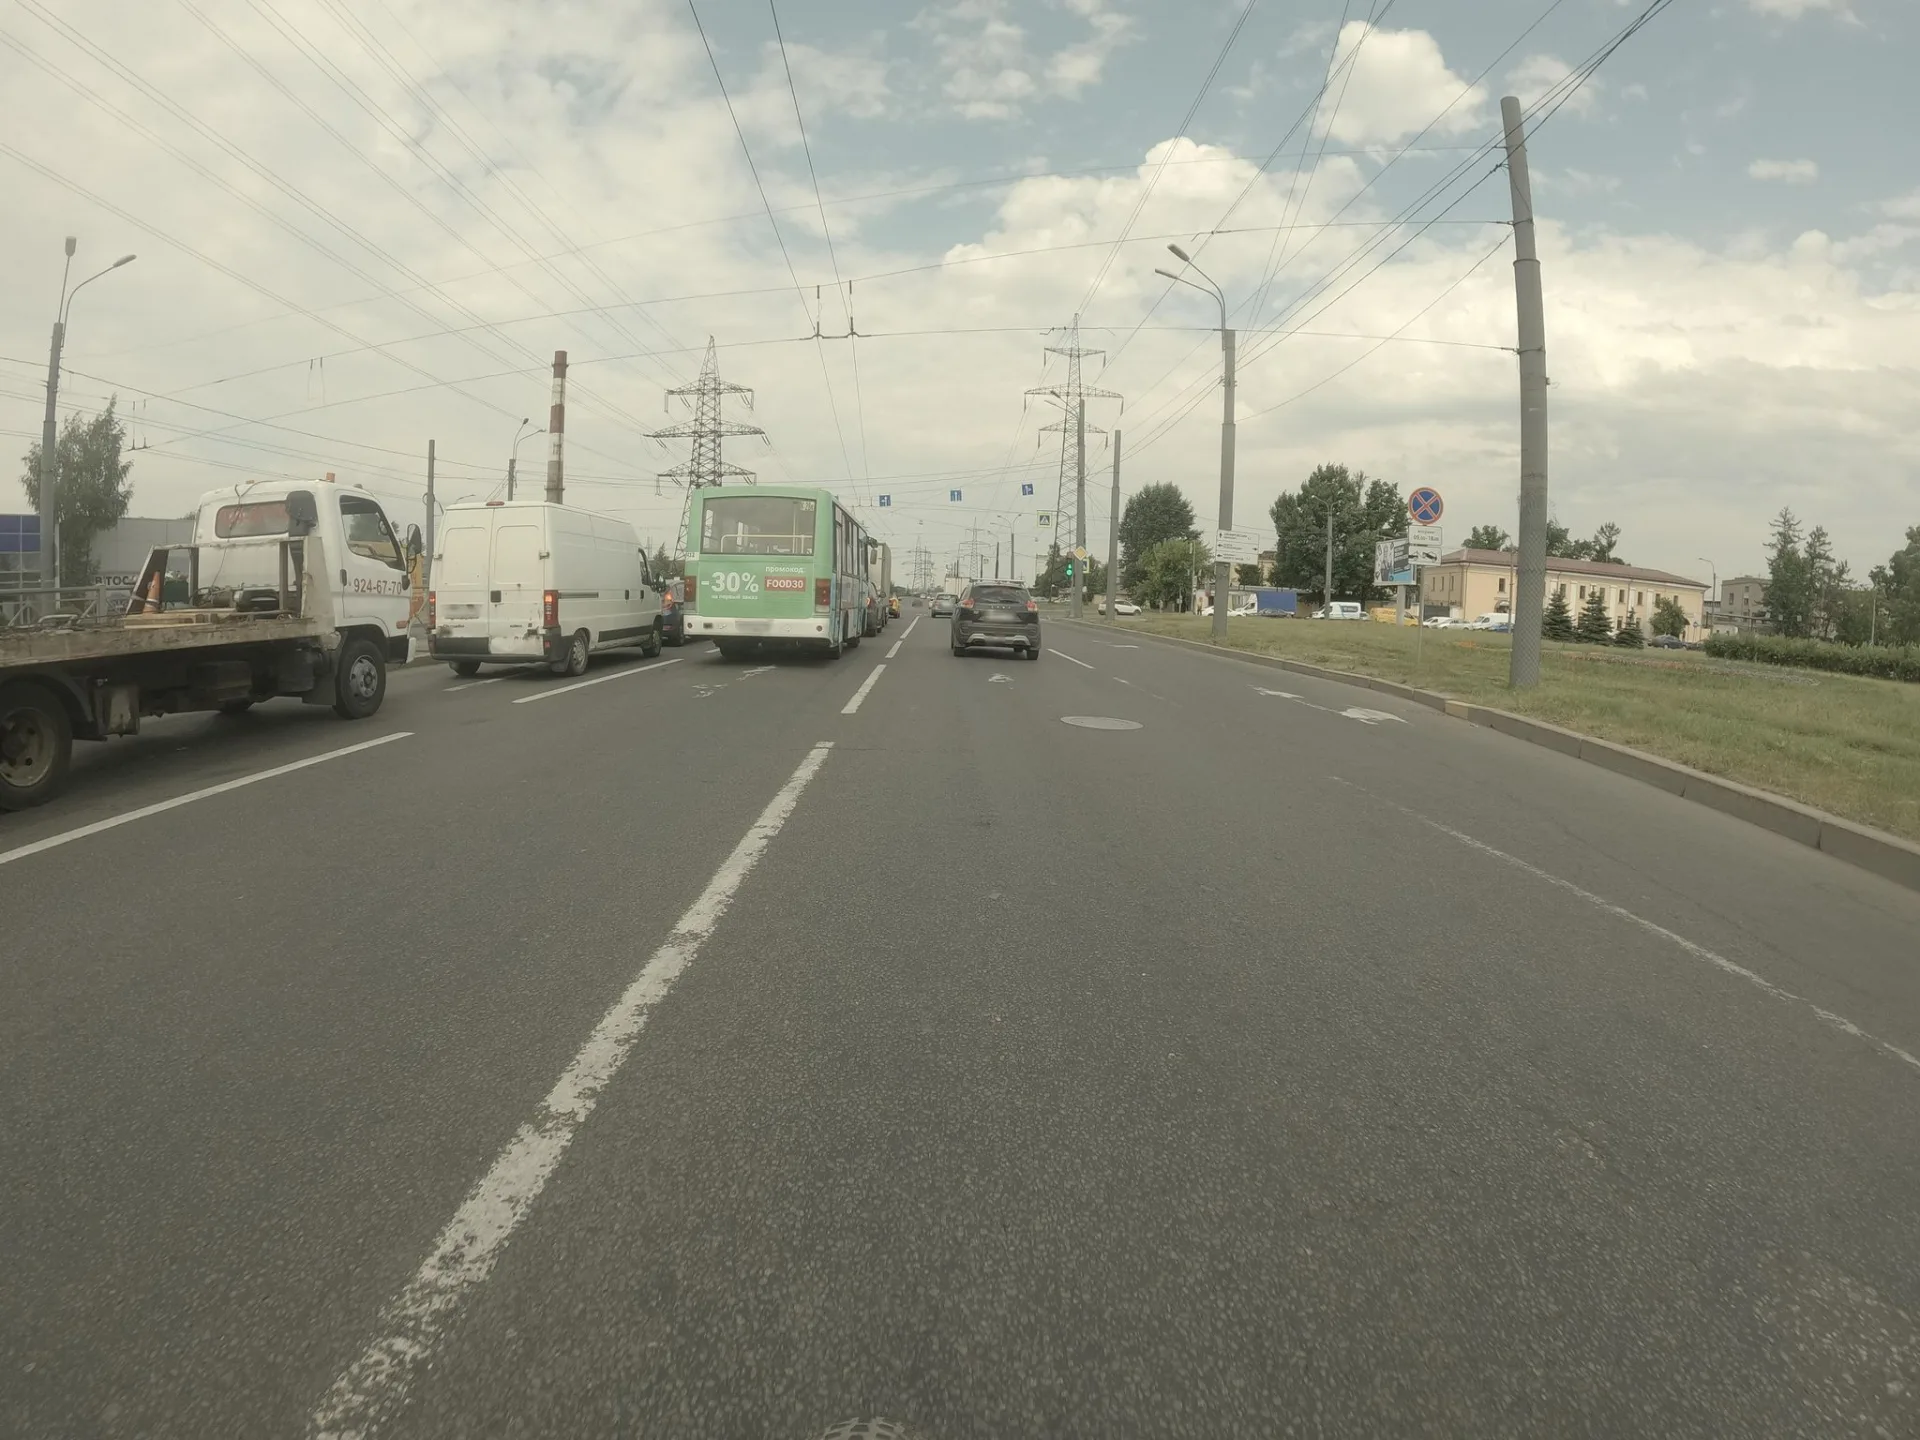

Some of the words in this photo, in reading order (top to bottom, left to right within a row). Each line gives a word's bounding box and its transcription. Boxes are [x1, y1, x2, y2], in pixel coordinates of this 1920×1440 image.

[354, 578, 402, 595] 924-67-70
[701, 571, 759, 593] -30%
[766, 579, 804, 589] FOOD30
